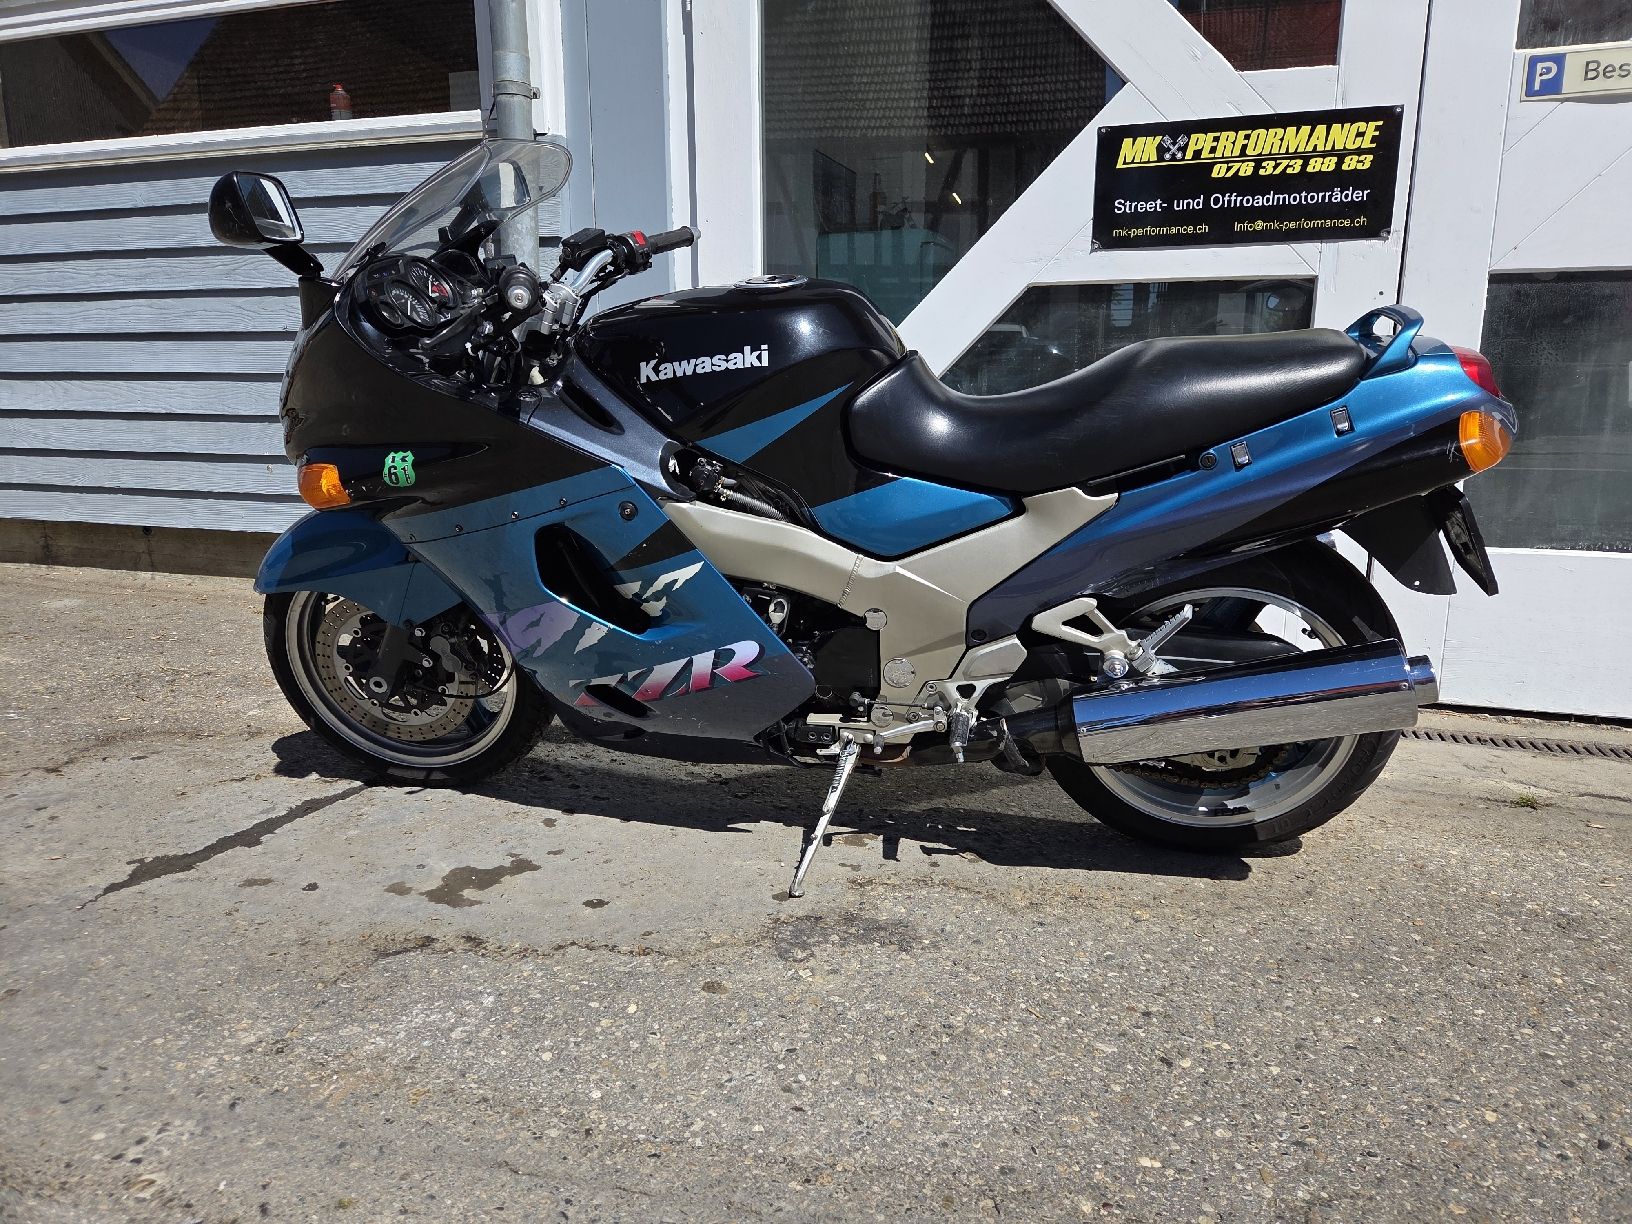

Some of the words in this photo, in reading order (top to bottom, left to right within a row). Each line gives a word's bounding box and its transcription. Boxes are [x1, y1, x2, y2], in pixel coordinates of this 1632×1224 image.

[1534, 61, 1558, 91] P
[1116, 134, 1163, 168] MK
[1184, 120, 1384, 160] PERFORMANCE
[1210, 161, 1255, 178] 076
[1258, 158, 1303, 176] 373
[1306, 156, 1338, 172] 88
[1341, 154, 1374, 171] 83
[1114, 198, 1168, 214] Street-
[1173, 194, 1204, 211] und
[1210, 186, 1371, 209] Offroadmotorräder
[1112, 222, 1209, 238] mk-performance.ch
[1234, 215, 1367, 232] Info@mk-performance.ch
[639, 344, 769, 384] Kawasaki
